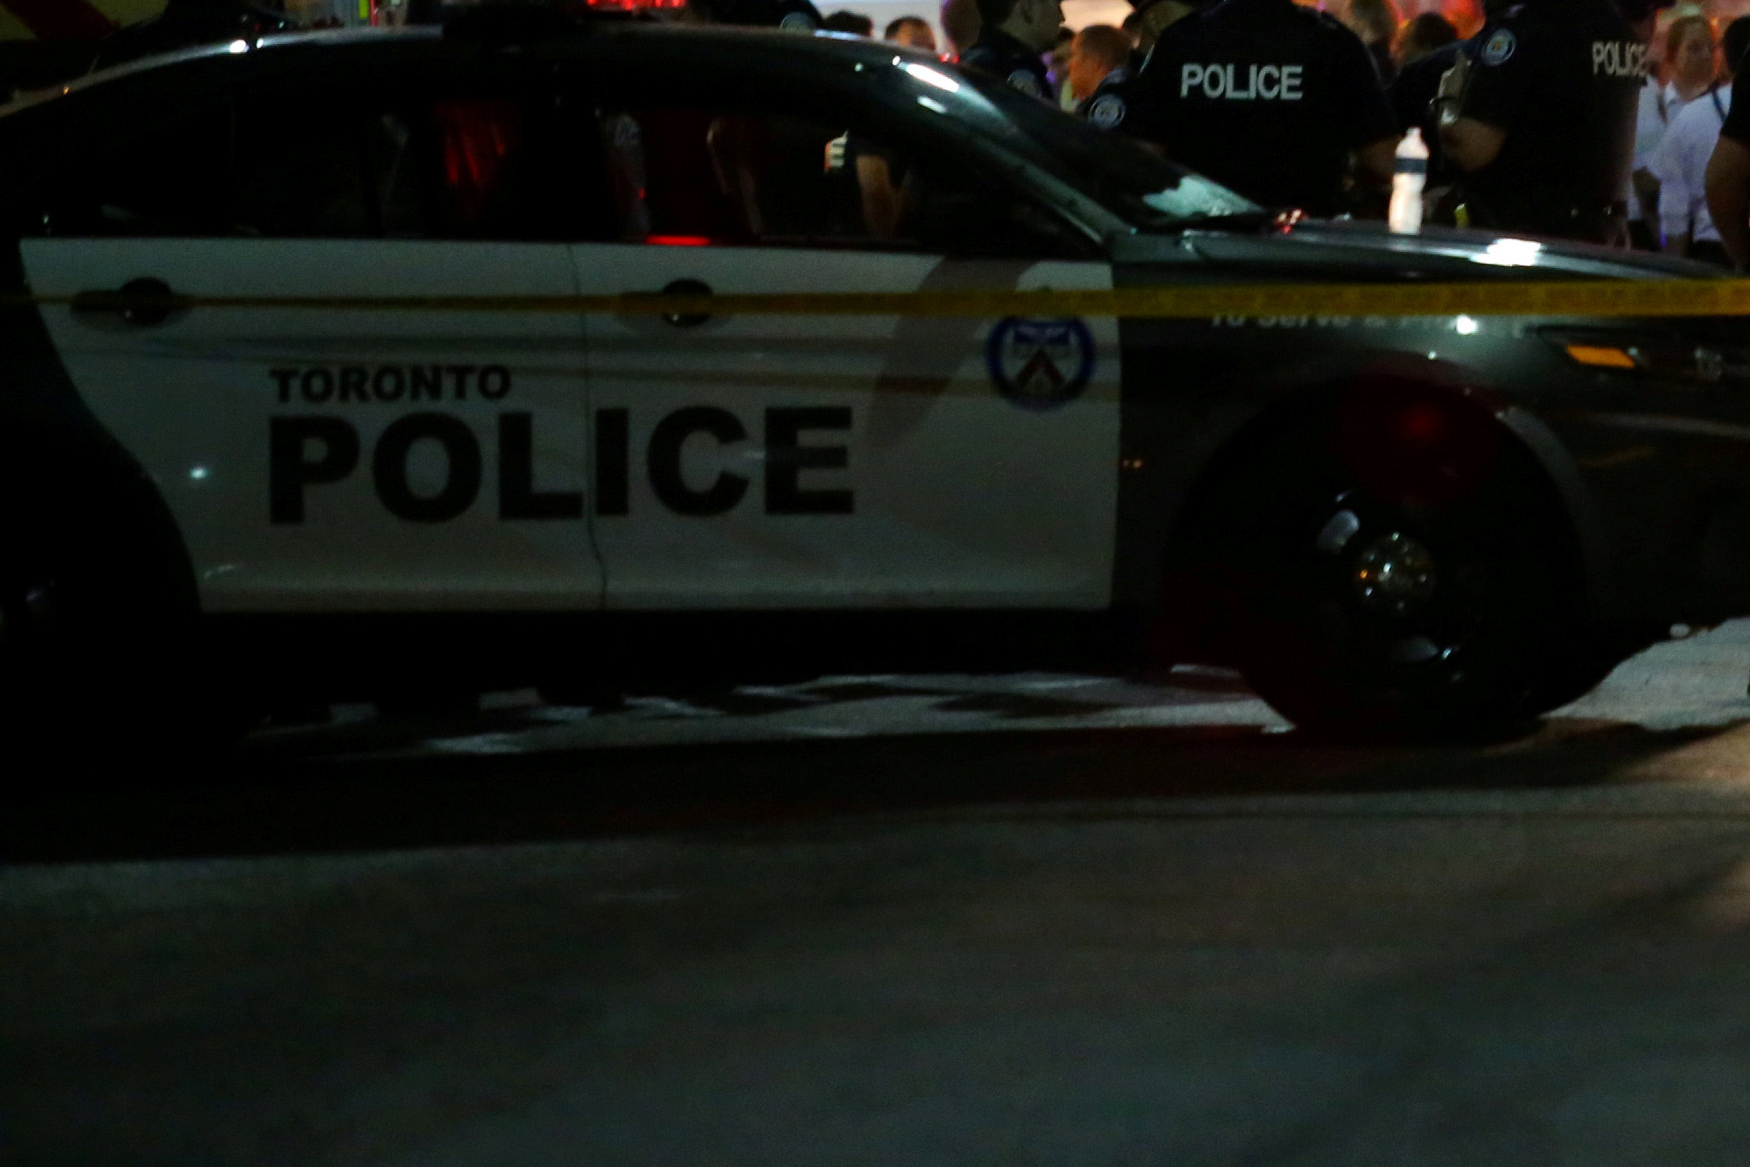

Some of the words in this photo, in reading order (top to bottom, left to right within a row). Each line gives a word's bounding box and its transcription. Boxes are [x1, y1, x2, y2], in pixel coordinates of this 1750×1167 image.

[1591, 40, 1647, 77] POLICE
[1180, 63, 1304, 101] POLICE
[270, 365, 512, 404] TORONTO
[267, 405, 856, 525] POLICE
